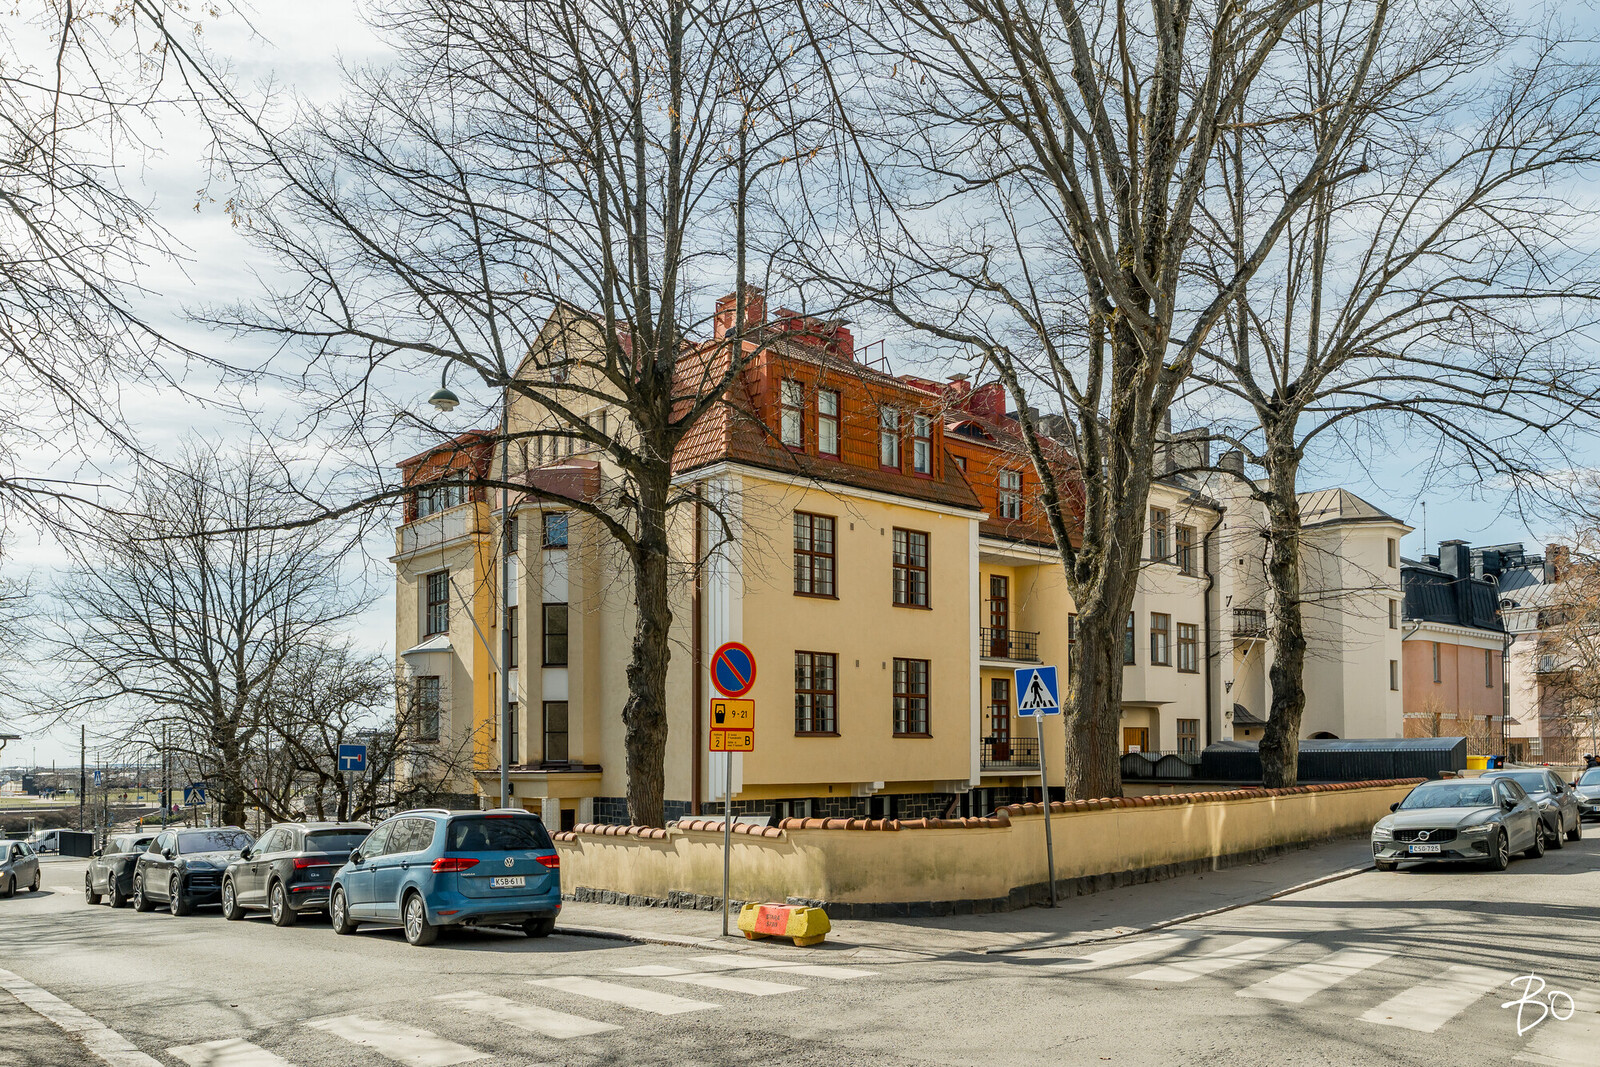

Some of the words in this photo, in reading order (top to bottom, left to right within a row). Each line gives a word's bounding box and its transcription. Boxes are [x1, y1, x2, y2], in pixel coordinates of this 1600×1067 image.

[715, 740, 720, 748] 2
[744, 735, 751, 746] B
[495, 877, 523, 886] KSB-611
